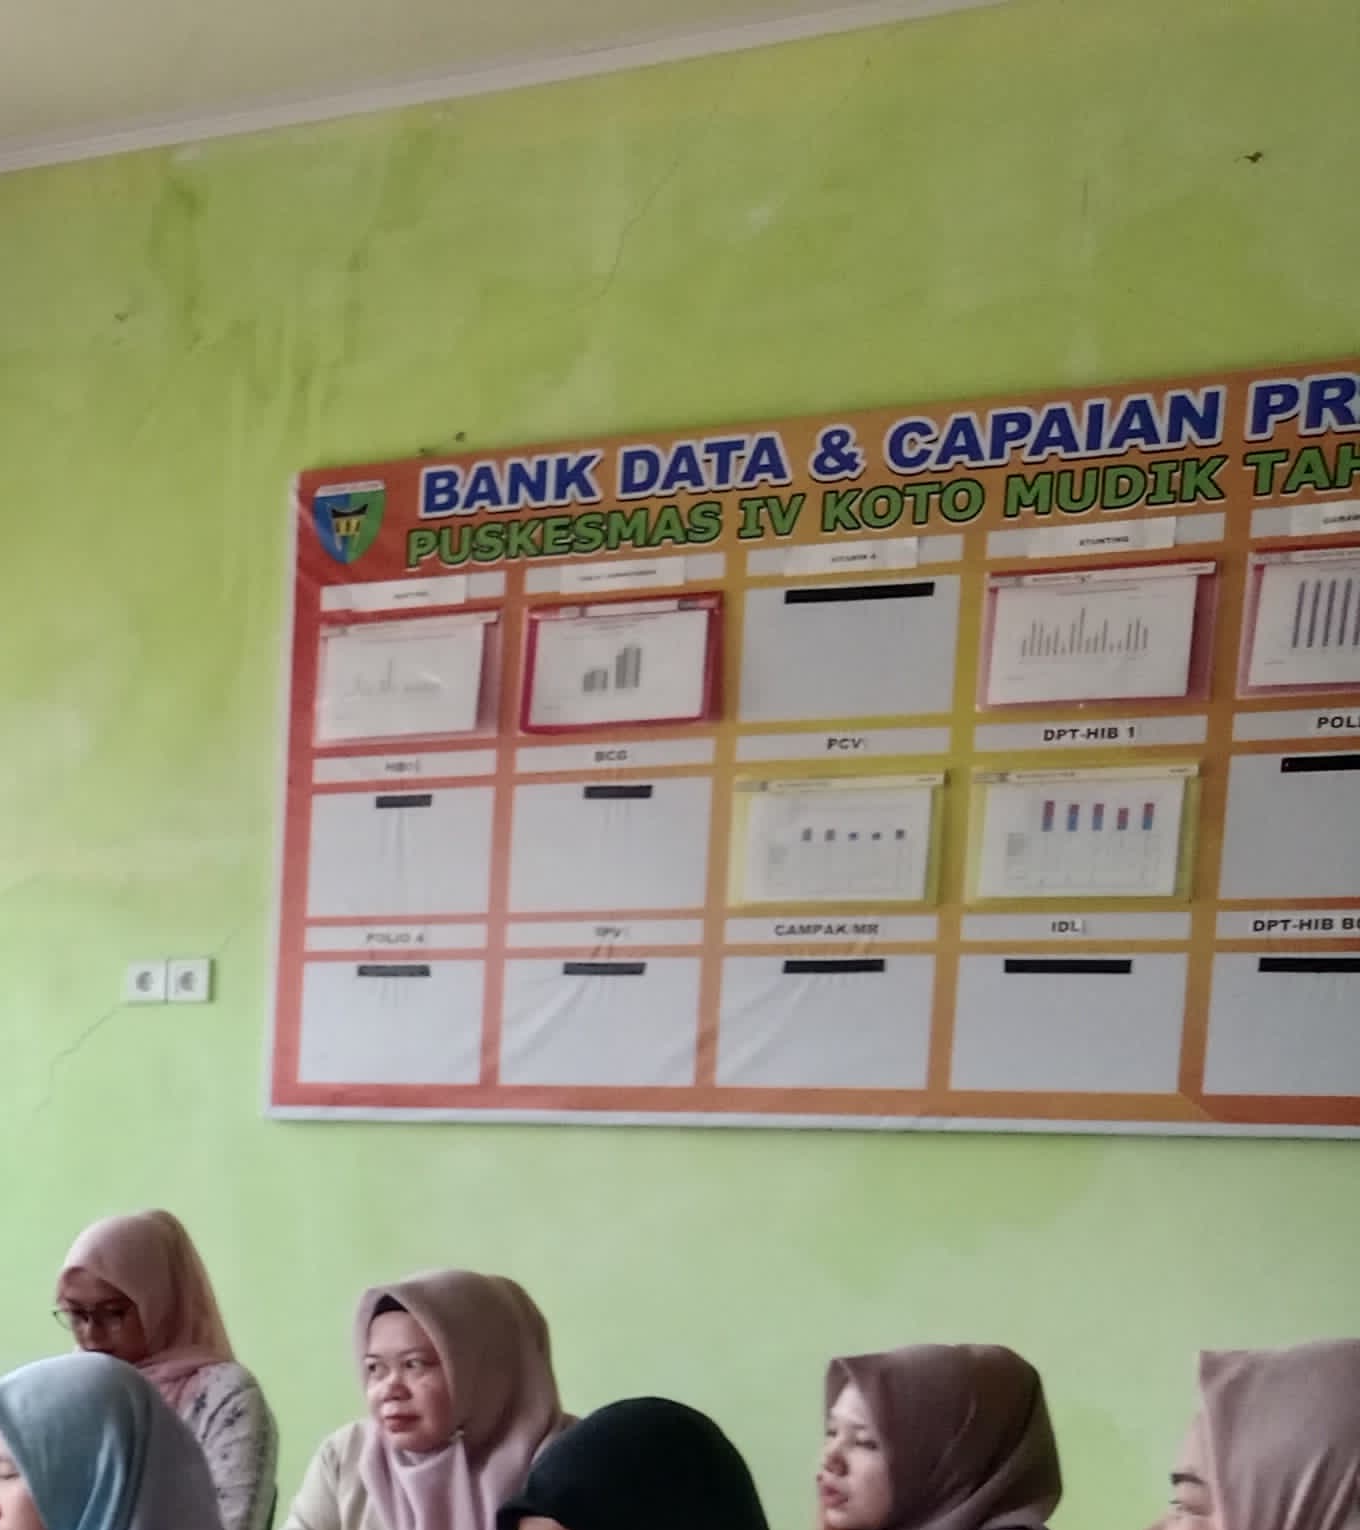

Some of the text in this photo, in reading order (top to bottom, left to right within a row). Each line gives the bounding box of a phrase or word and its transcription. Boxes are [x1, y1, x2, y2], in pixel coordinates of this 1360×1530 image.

[421, 376, 1360, 516] BANK DATA & CAPAIAN PR
[406, 500, 723, 567] PUSKESMAS
[737, 493, 807, 540] IV
[821, 476, 986, 534] KOTO
[1002, 454, 1229, 518] MUDIK
[1043, 725, 1136, 742] DPT-HIB 1
[826, 737, 864, 750] PCV
[593, 749, 629, 763] BCG
[1050, 919, 1081, 934] IDL
[1252, 917, 1360, 933] DPT-HIB B
